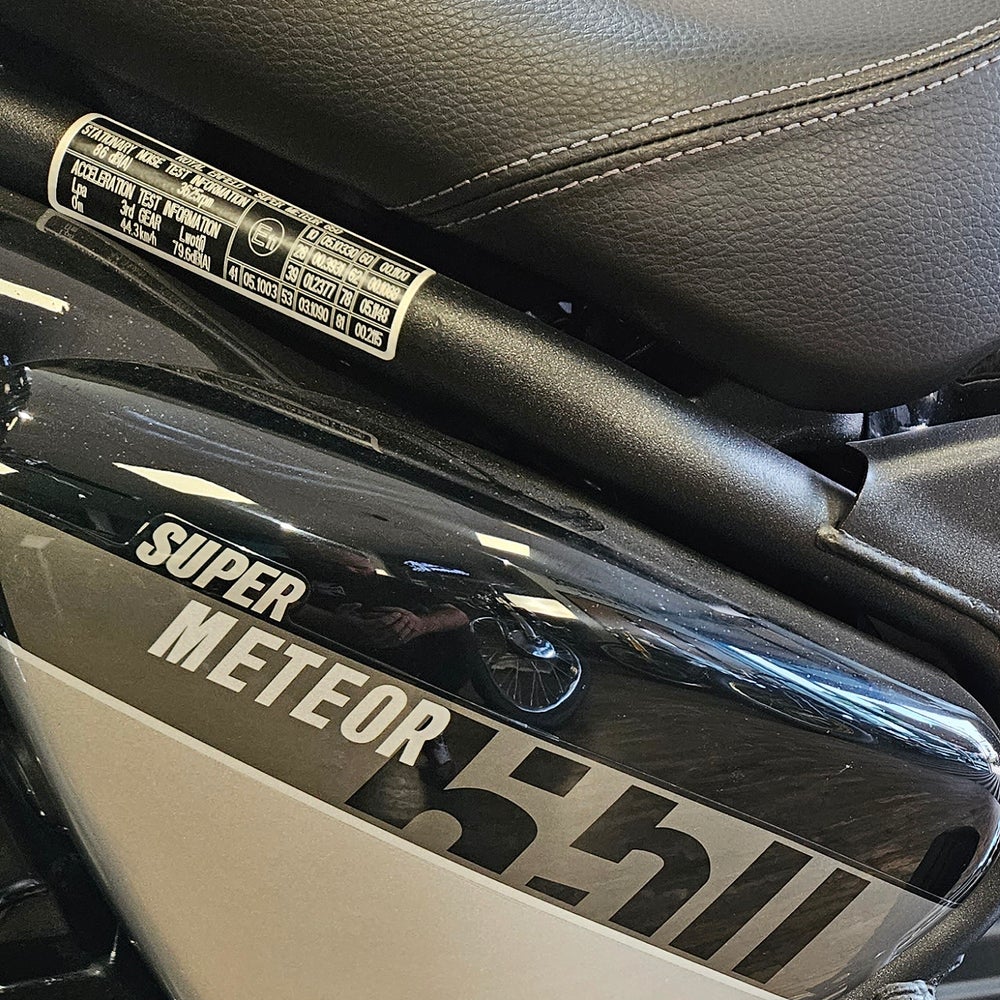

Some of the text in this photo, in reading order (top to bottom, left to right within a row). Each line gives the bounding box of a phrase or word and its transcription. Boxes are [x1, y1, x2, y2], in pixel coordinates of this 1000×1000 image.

[81, 124, 251, 208] STATIONARY NOISE TEST INFORMATION
[93, 143, 110, 159] 86
[70, 159, 222, 239] ACCELERATION TEST INFORMATION
[120, 199, 162, 231] 3rd GEAR
[285, 264, 300, 283] 39
[339, 289, 354, 307] 78
[347, 265, 364, 285] 62
[358, 252, 375, 266] 60
[228, 265, 239, 282] 41
[243, 274, 278, 300] 05.1003
[280, 289, 293, 307] 53
[335, 313, 346, 330] 81
[135, 521, 307, 623] SUPER
[147, 599, 451, 767] METEOR
